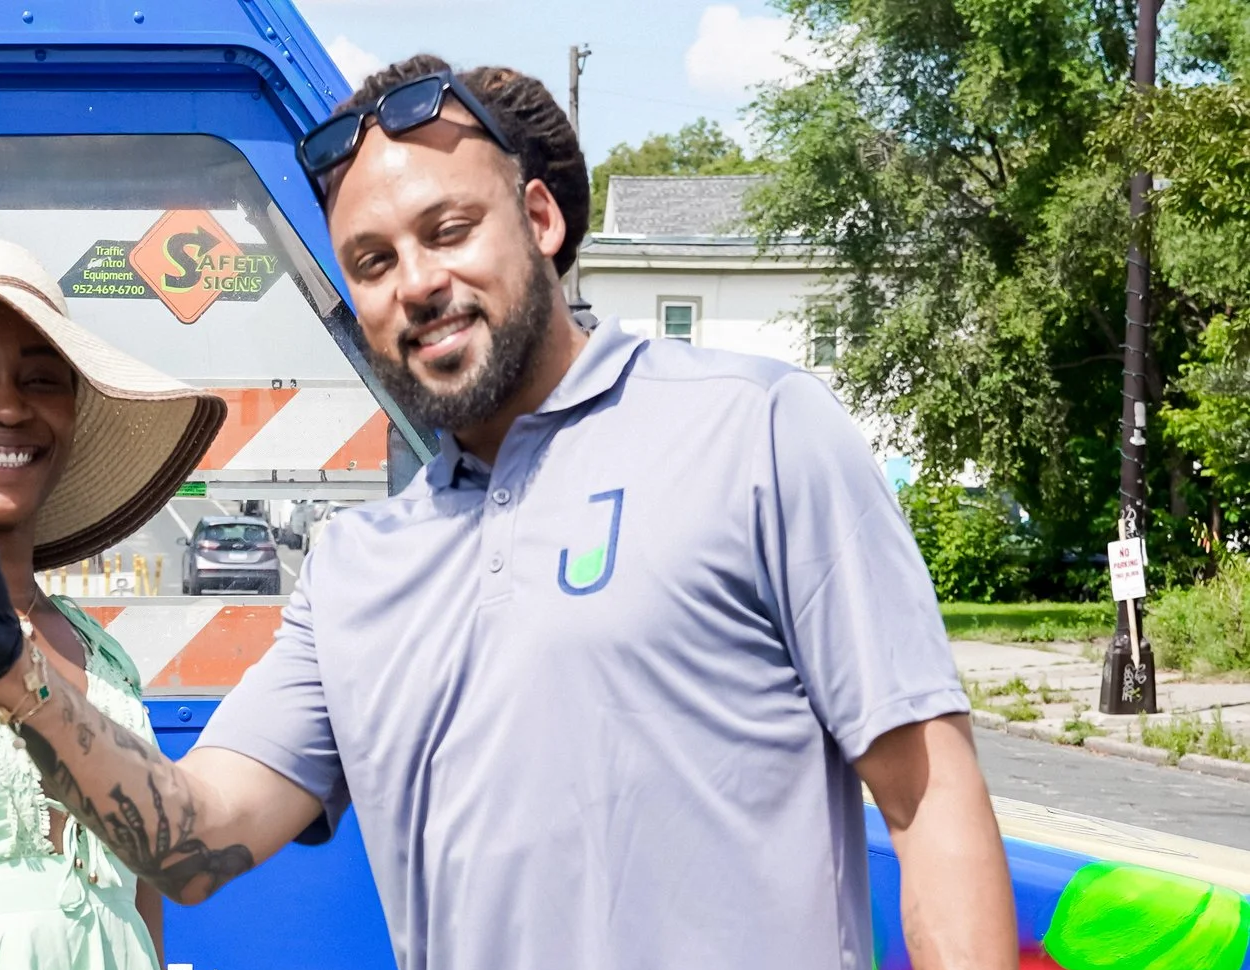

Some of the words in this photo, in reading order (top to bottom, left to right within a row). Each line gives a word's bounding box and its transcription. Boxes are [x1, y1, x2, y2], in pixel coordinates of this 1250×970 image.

[95, 246, 125, 256] Traffic
[83, 270, 134, 282] Equipment
[72, 284, 145, 295] 952-469-6700
[202, 275, 262, 293] SIGNS
